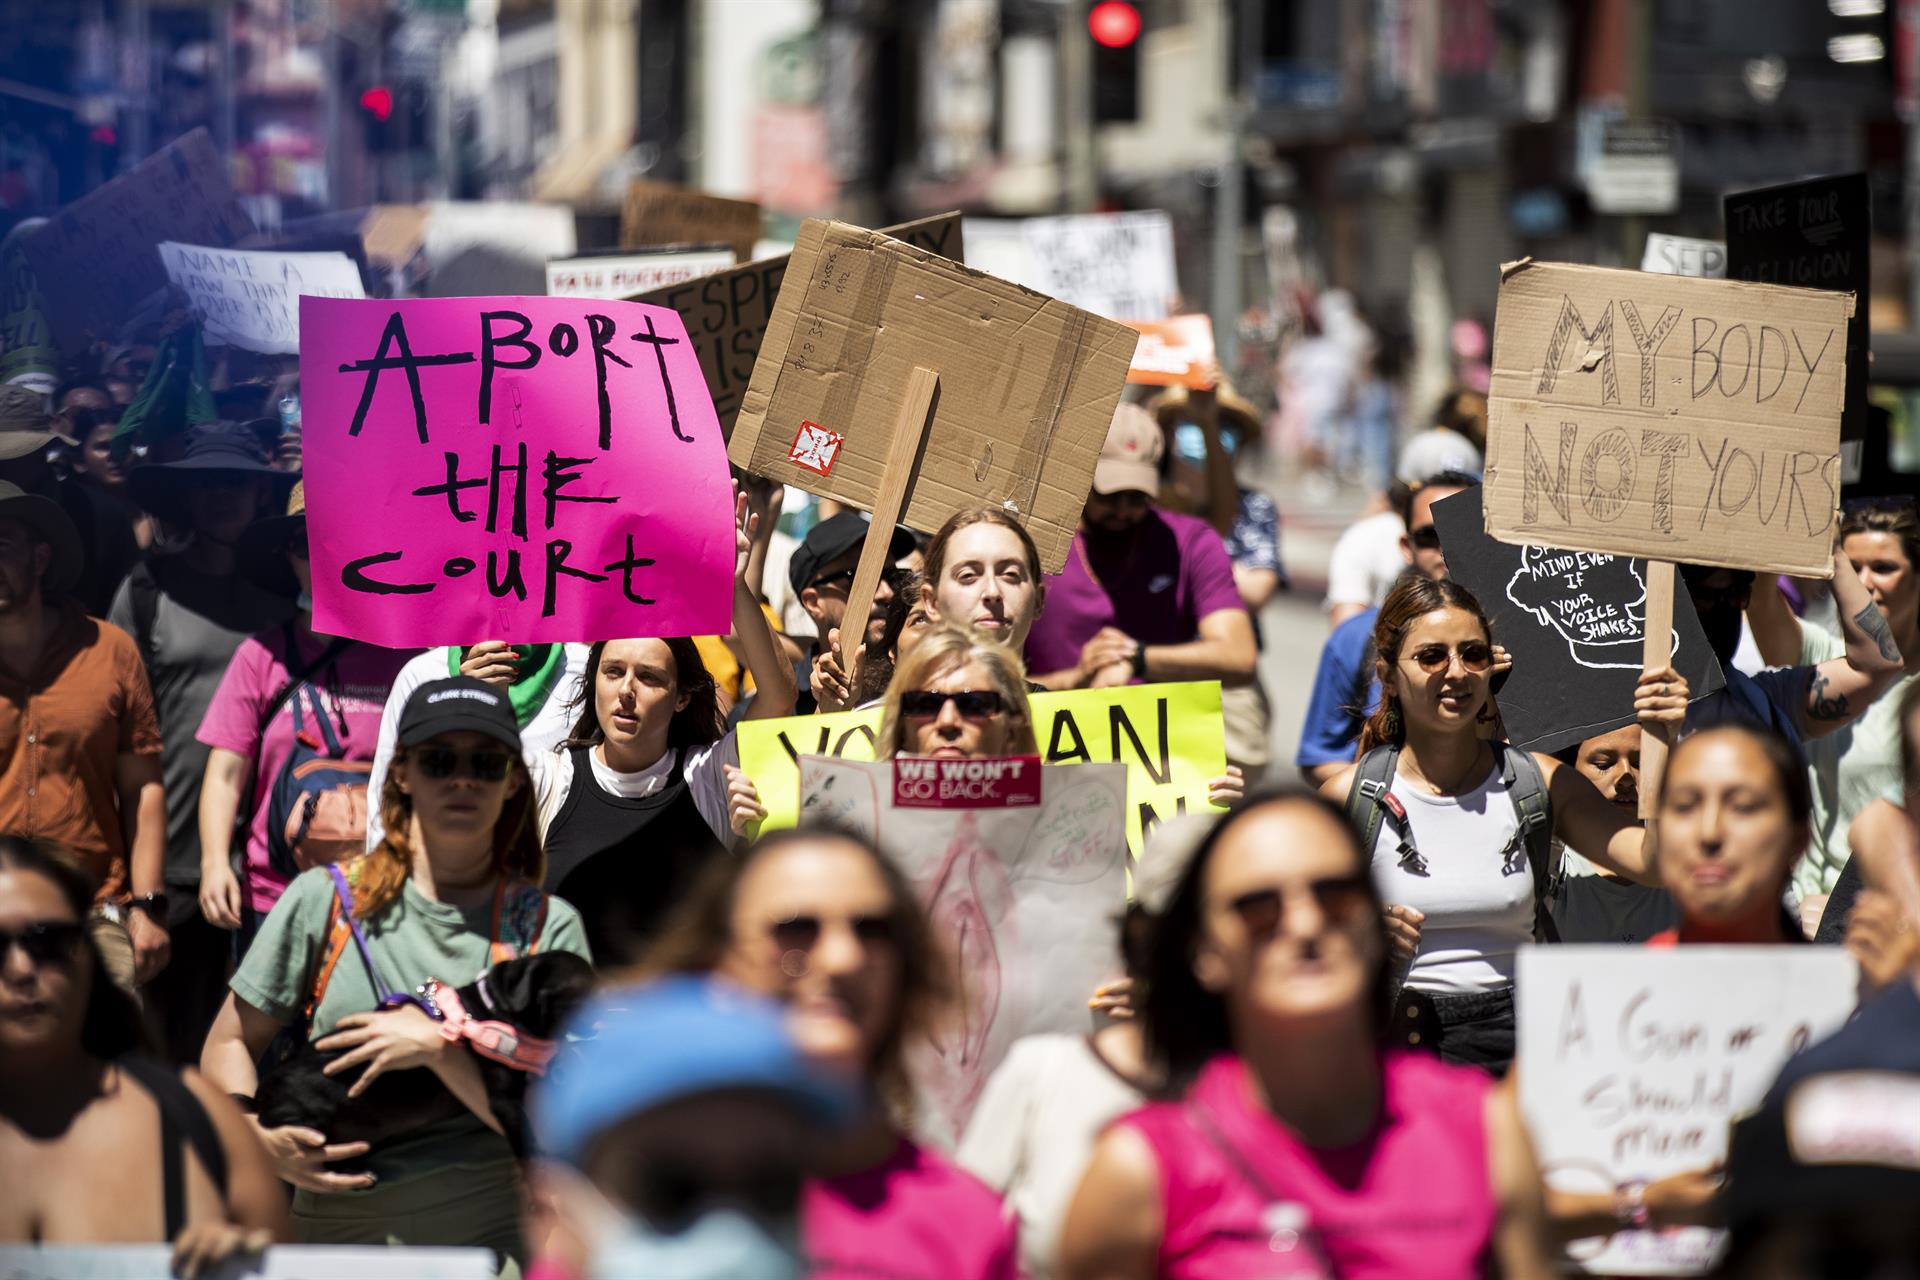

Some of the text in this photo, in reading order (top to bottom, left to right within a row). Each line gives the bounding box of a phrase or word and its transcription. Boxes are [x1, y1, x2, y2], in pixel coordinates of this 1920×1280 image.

[1733, 197, 1787, 234] TAKE
[1537, 293, 1835, 414] MY BODY
[1522, 421, 1842, 538] NOT YOURS
[1531, 555, 1575, 582] MIND
[1574, 551, 1615, 571] EVEN
[1563, 571, 1585, 590] IF
[1550, 593, 1595, 616] YOUR
[1561, 603, 1618, 628] VOICE
[1579, 618, 1643, 642] SHAKES.
[1045, 697, 1172, 785] AN
[897, 759, 1025, 781] WE WON'T
[897, 779, 936, 799] GO
[1555, 977, 1593, 1062] A
